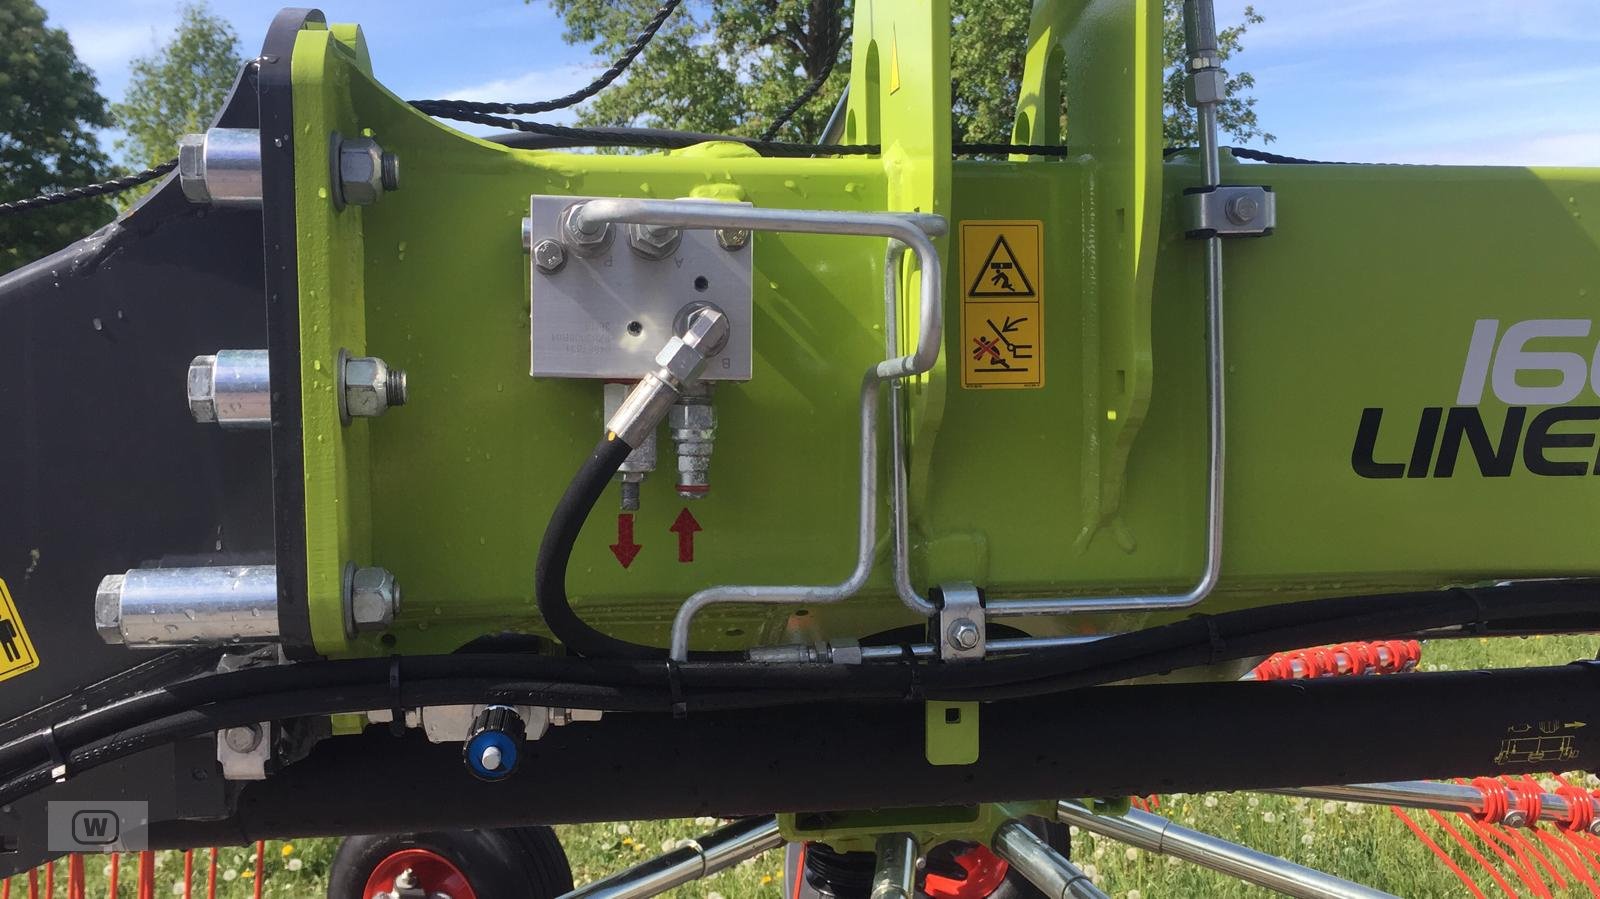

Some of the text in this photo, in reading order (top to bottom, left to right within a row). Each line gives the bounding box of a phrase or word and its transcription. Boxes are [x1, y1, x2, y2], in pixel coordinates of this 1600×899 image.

[674, 257, 684, 268] A
[722, 358, 731, 369] B
[1456, 319, 1600, 405] 16
[1351, 406, 1600, 479] LINE
